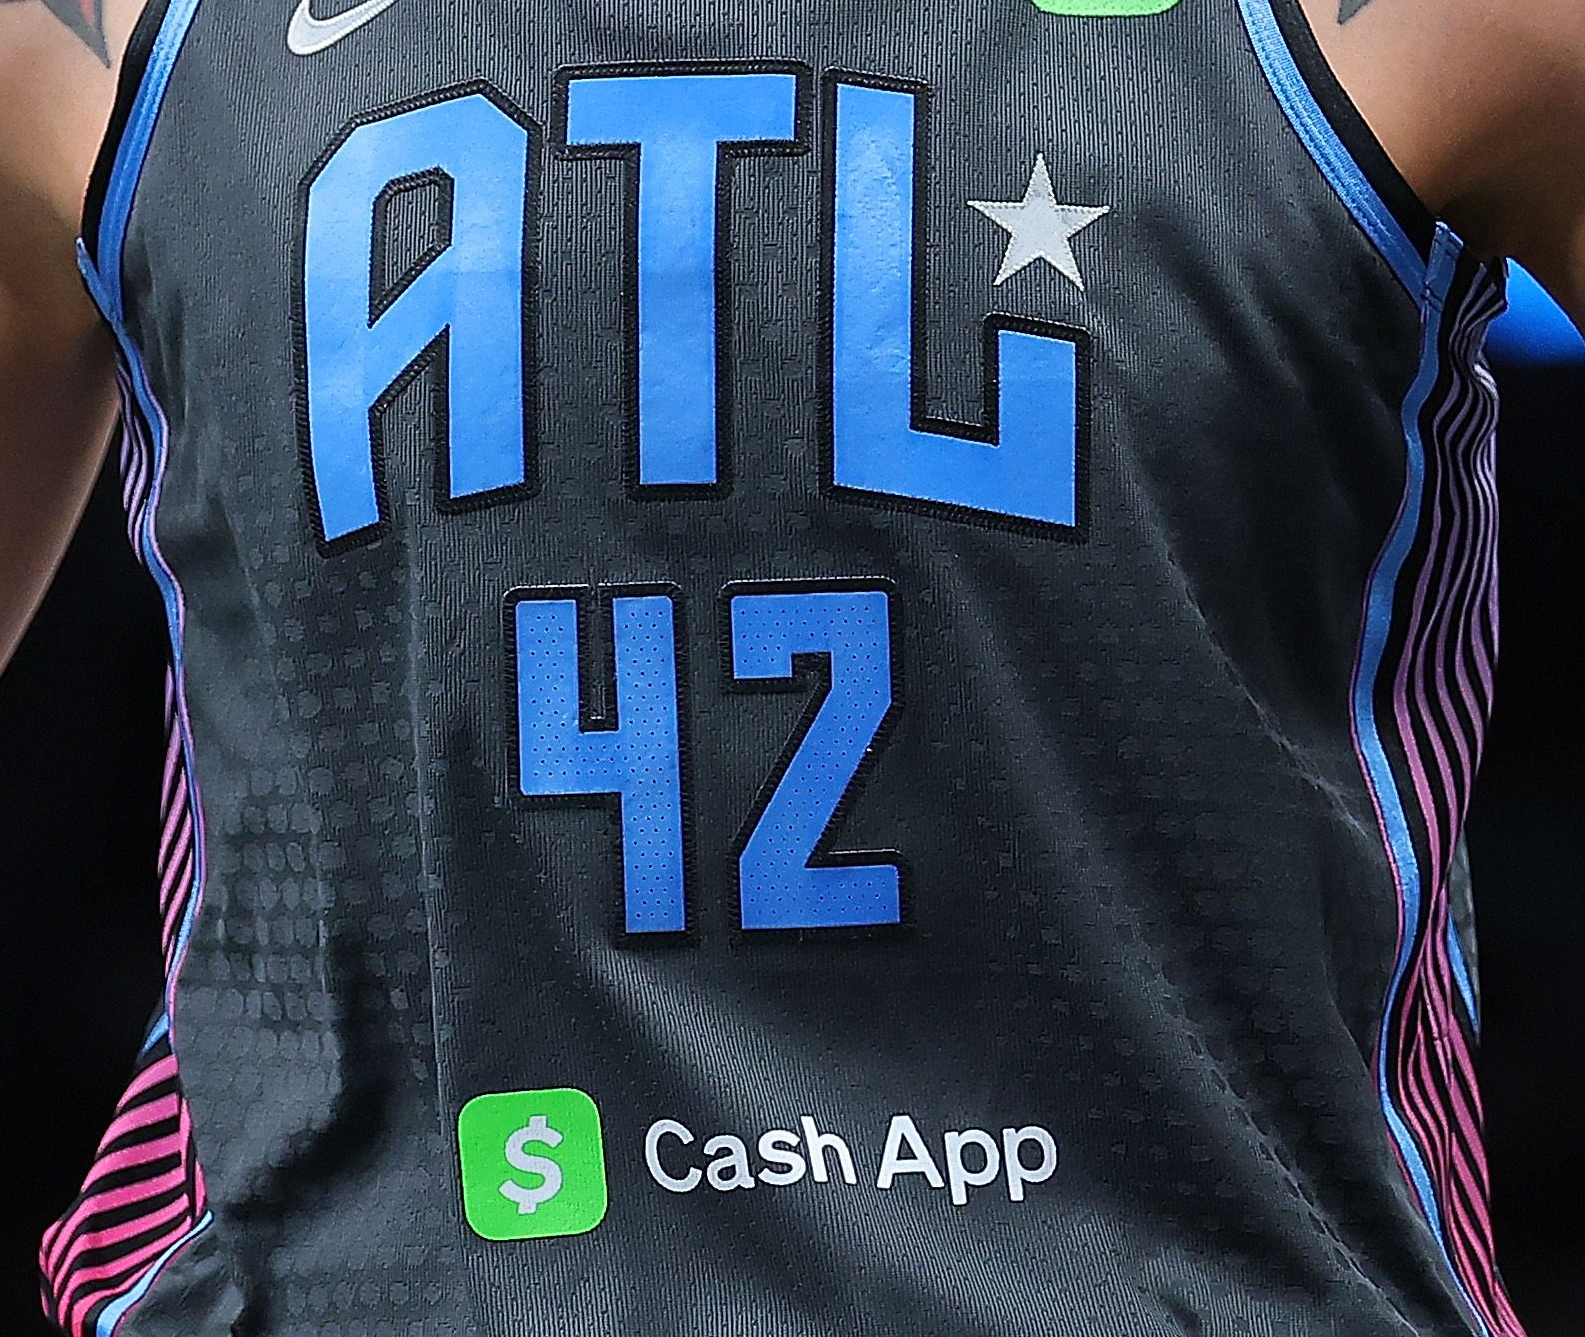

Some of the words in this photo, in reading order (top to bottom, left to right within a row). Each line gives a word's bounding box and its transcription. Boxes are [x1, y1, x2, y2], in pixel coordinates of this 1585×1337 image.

[302, 72, 1079, 542] ATL
[513, 589, 902, 935] 42
[644, 1115, 858, 1193] Cash
[876, 1114, 1058, 1207] App
